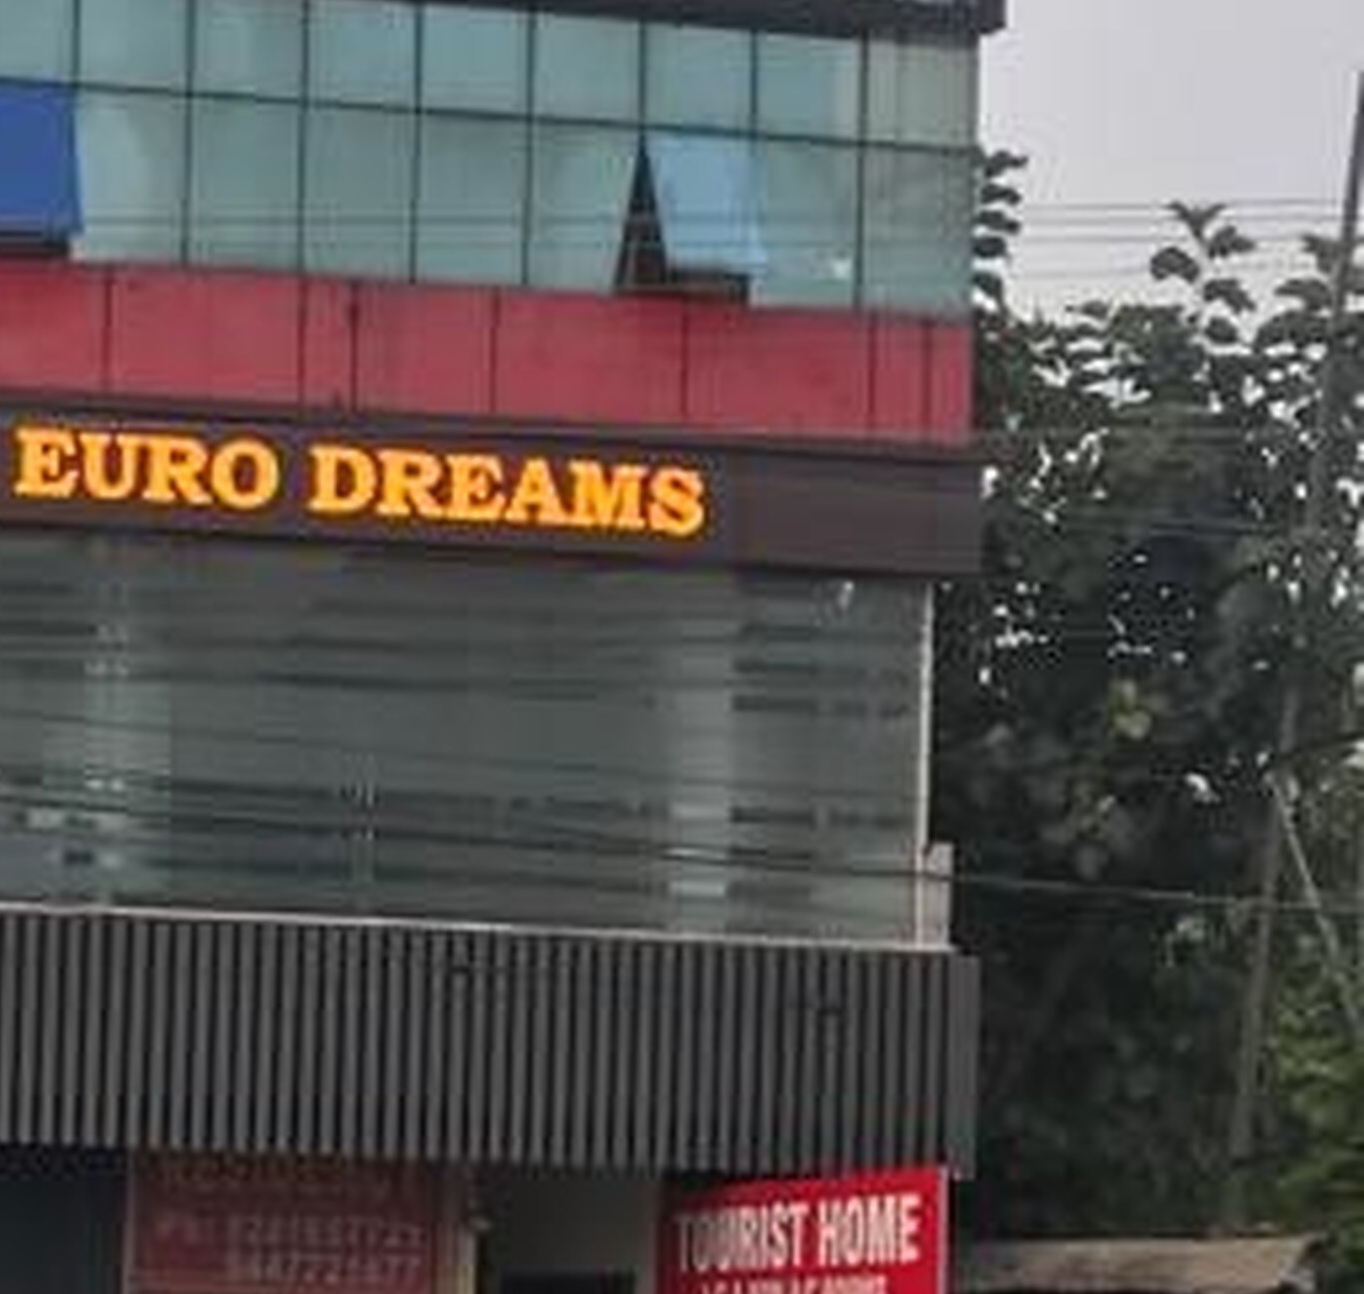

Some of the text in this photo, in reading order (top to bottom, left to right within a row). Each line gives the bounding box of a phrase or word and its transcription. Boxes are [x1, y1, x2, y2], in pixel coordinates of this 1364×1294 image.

[13, 426, 706, 536] EURO DREAMS
[675, 1193, 921, 1273] TOURIST HOME
